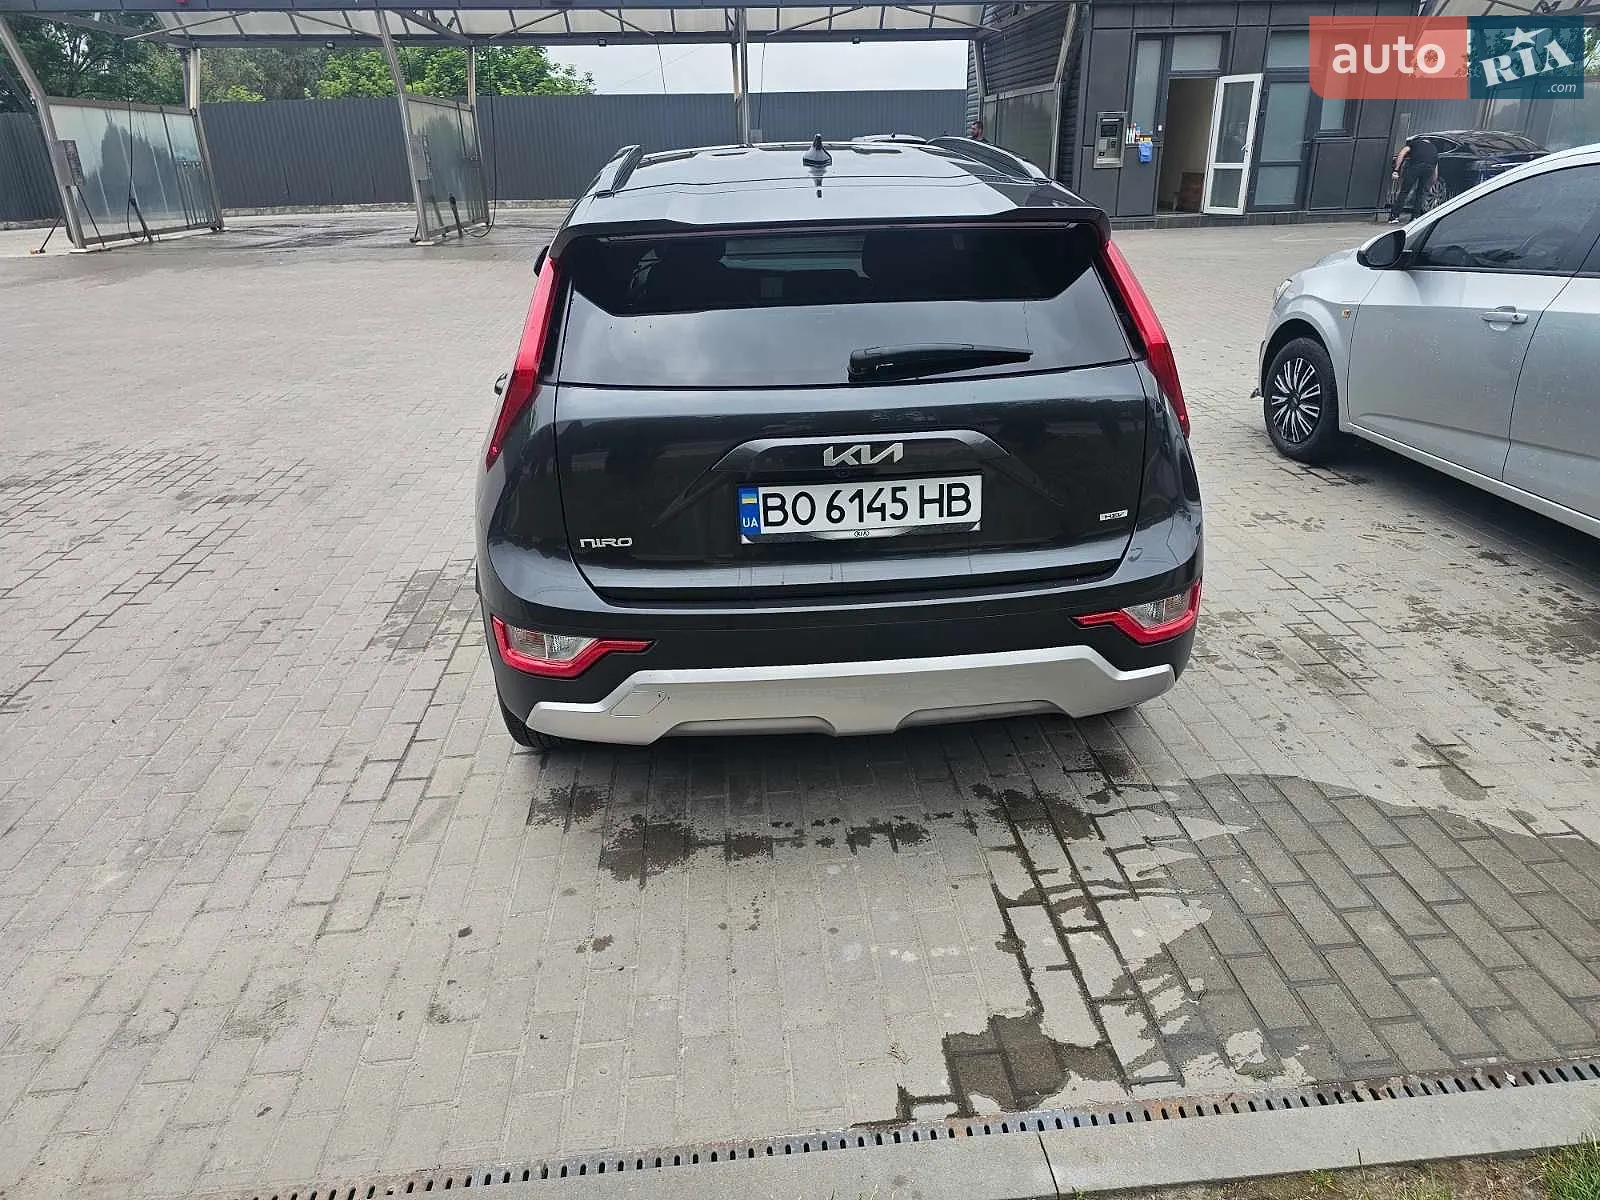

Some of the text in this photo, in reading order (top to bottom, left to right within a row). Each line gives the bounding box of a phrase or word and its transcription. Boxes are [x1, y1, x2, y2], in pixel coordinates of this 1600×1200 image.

[823, 442, 904, 467] KIA
[761, 482, 972, 527] BO 6145 HB
[742, 518, 759, 529] UA
[579, 537, 633, 549] NIRO
